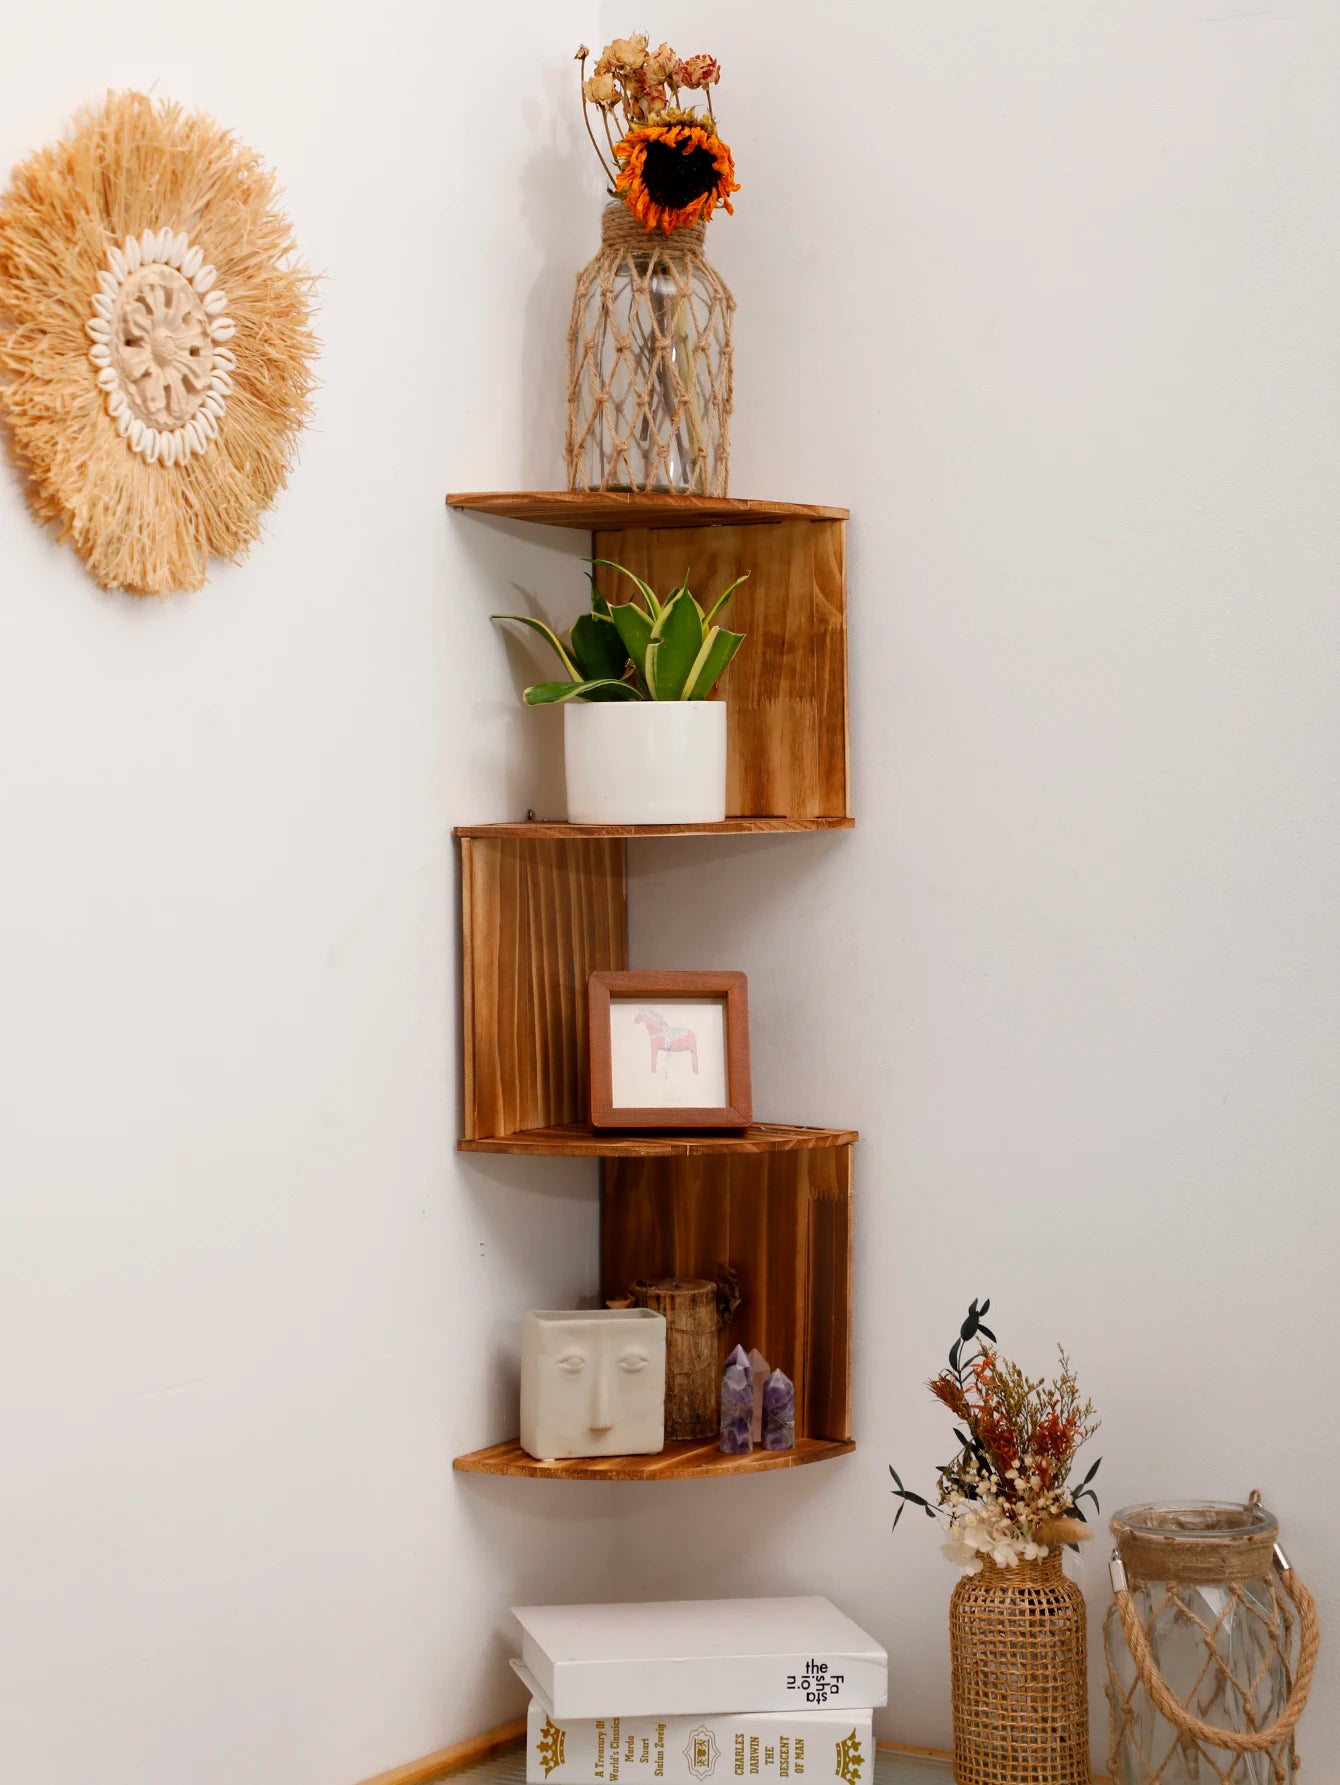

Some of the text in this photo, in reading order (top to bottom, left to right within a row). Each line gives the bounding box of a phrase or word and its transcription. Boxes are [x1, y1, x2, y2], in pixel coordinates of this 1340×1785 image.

[805, 1658, 828, 1674] the
[594, 1731, 606, 1768] Treasury
[639, 1738, 649, 1763] Stuart
[654, 1723, 666, 1748] Zweig
[609, 1751, 619, 1781] World's
[734, 1733, 744, 1775] CHARLES
[749, 1736, 759, 1774] DARWIN
[764, 1746, 774, 1765] THE
[779, 1735, 789, 1777] DESCENT
[794, 1738, 804, 1773] OF MAN
